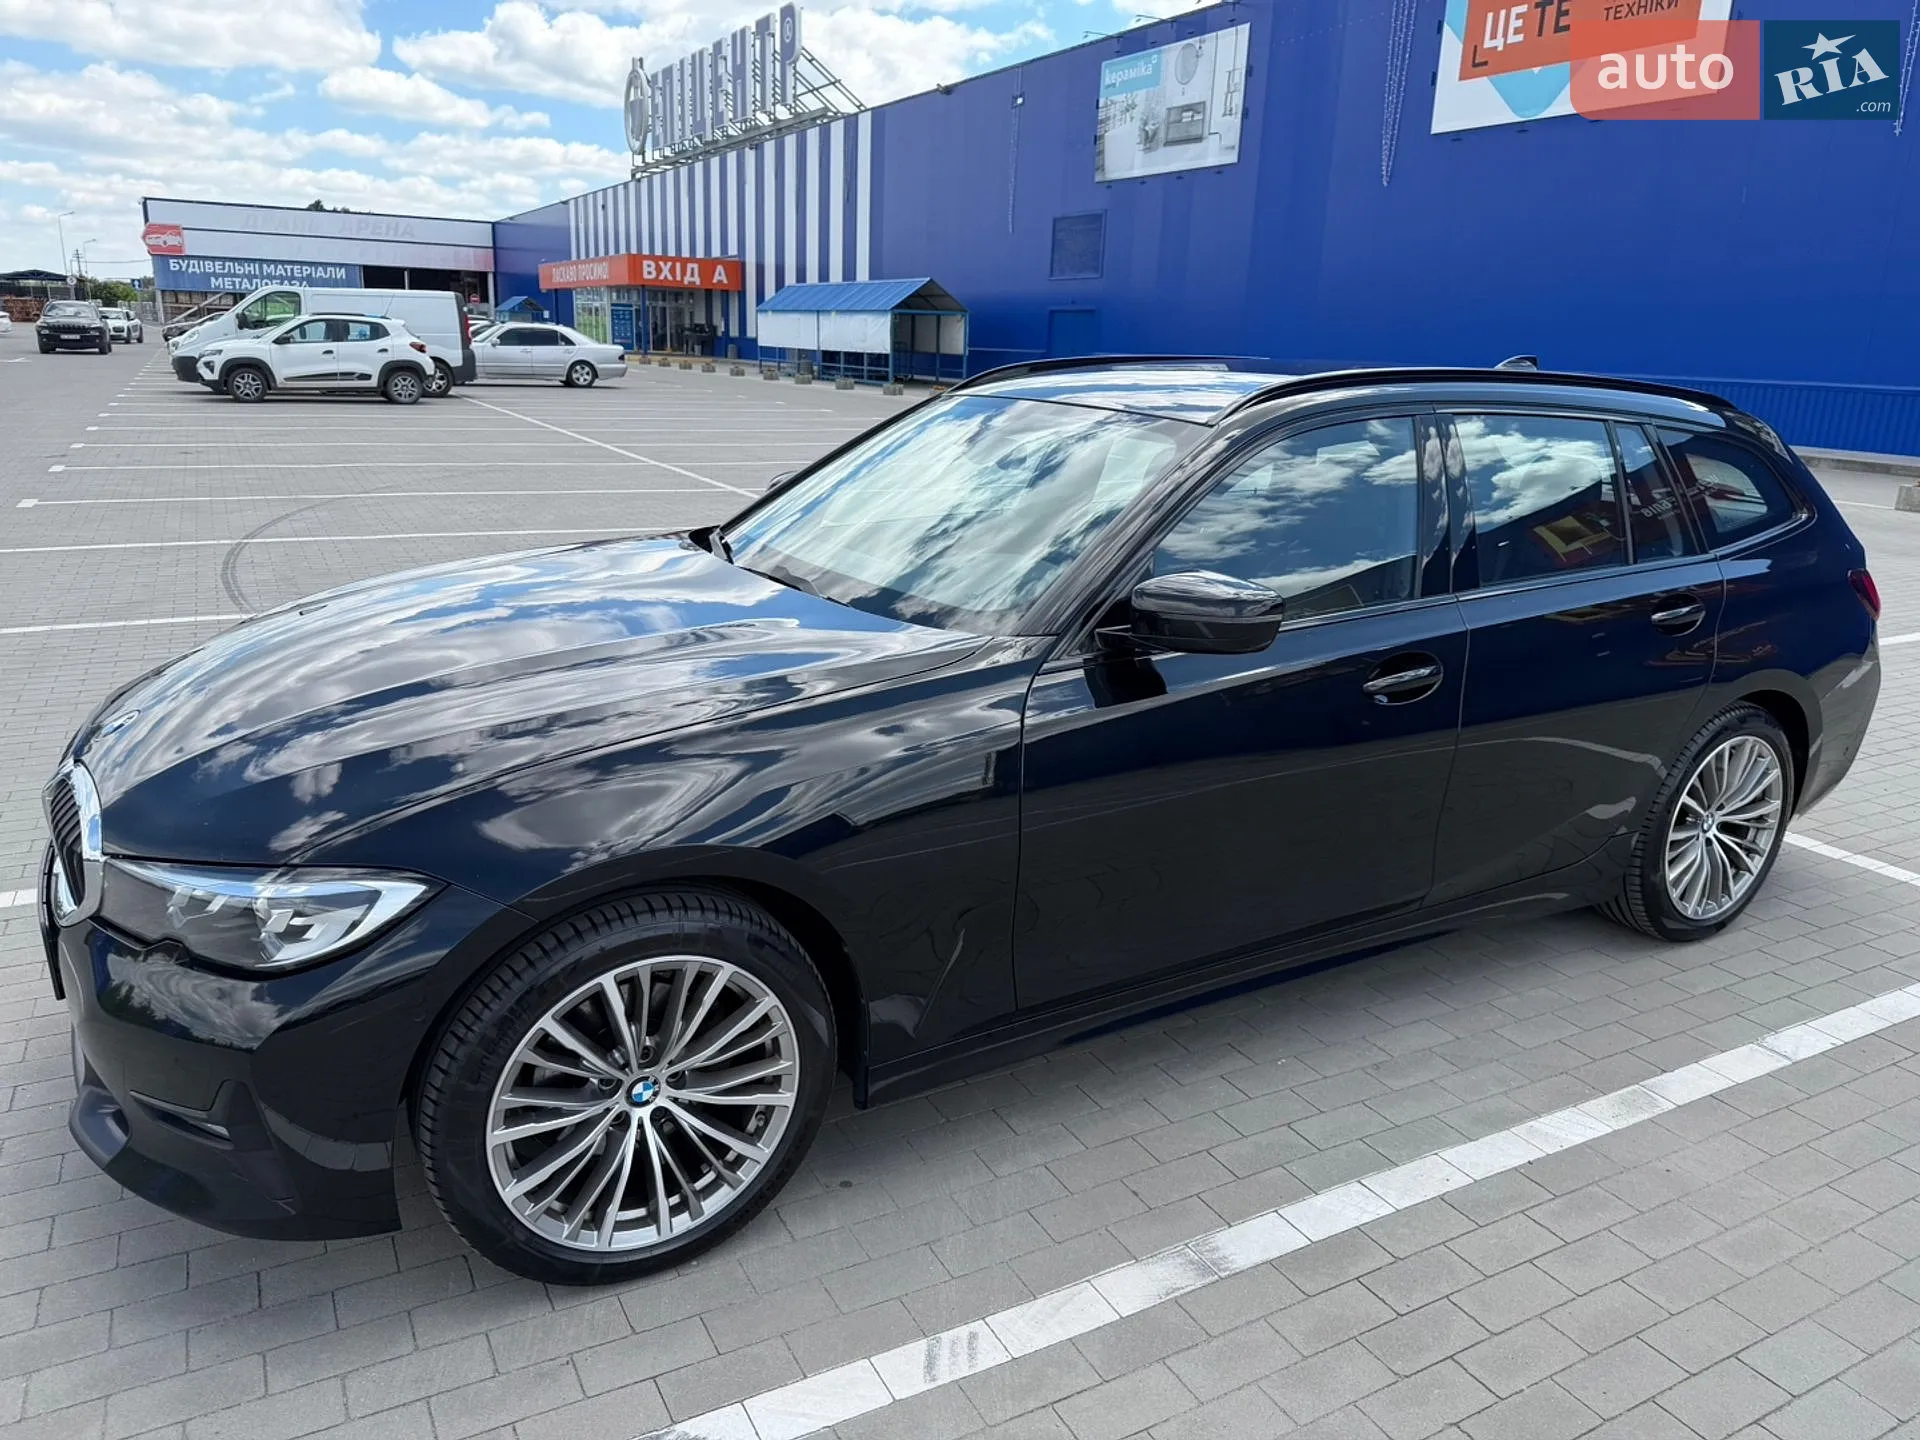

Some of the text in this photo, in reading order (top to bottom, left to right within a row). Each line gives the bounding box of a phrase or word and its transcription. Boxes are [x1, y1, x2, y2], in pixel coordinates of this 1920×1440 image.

[1483, 6, 1524, 51] ЦЕ
[169, 258, 346, 279] БУДІВЕЛЬНІ МАТЕРІАЛИ
[553, 266, 577, 282] ЛАСКАВО
[642, 260, 728, 285] ВХІД А
